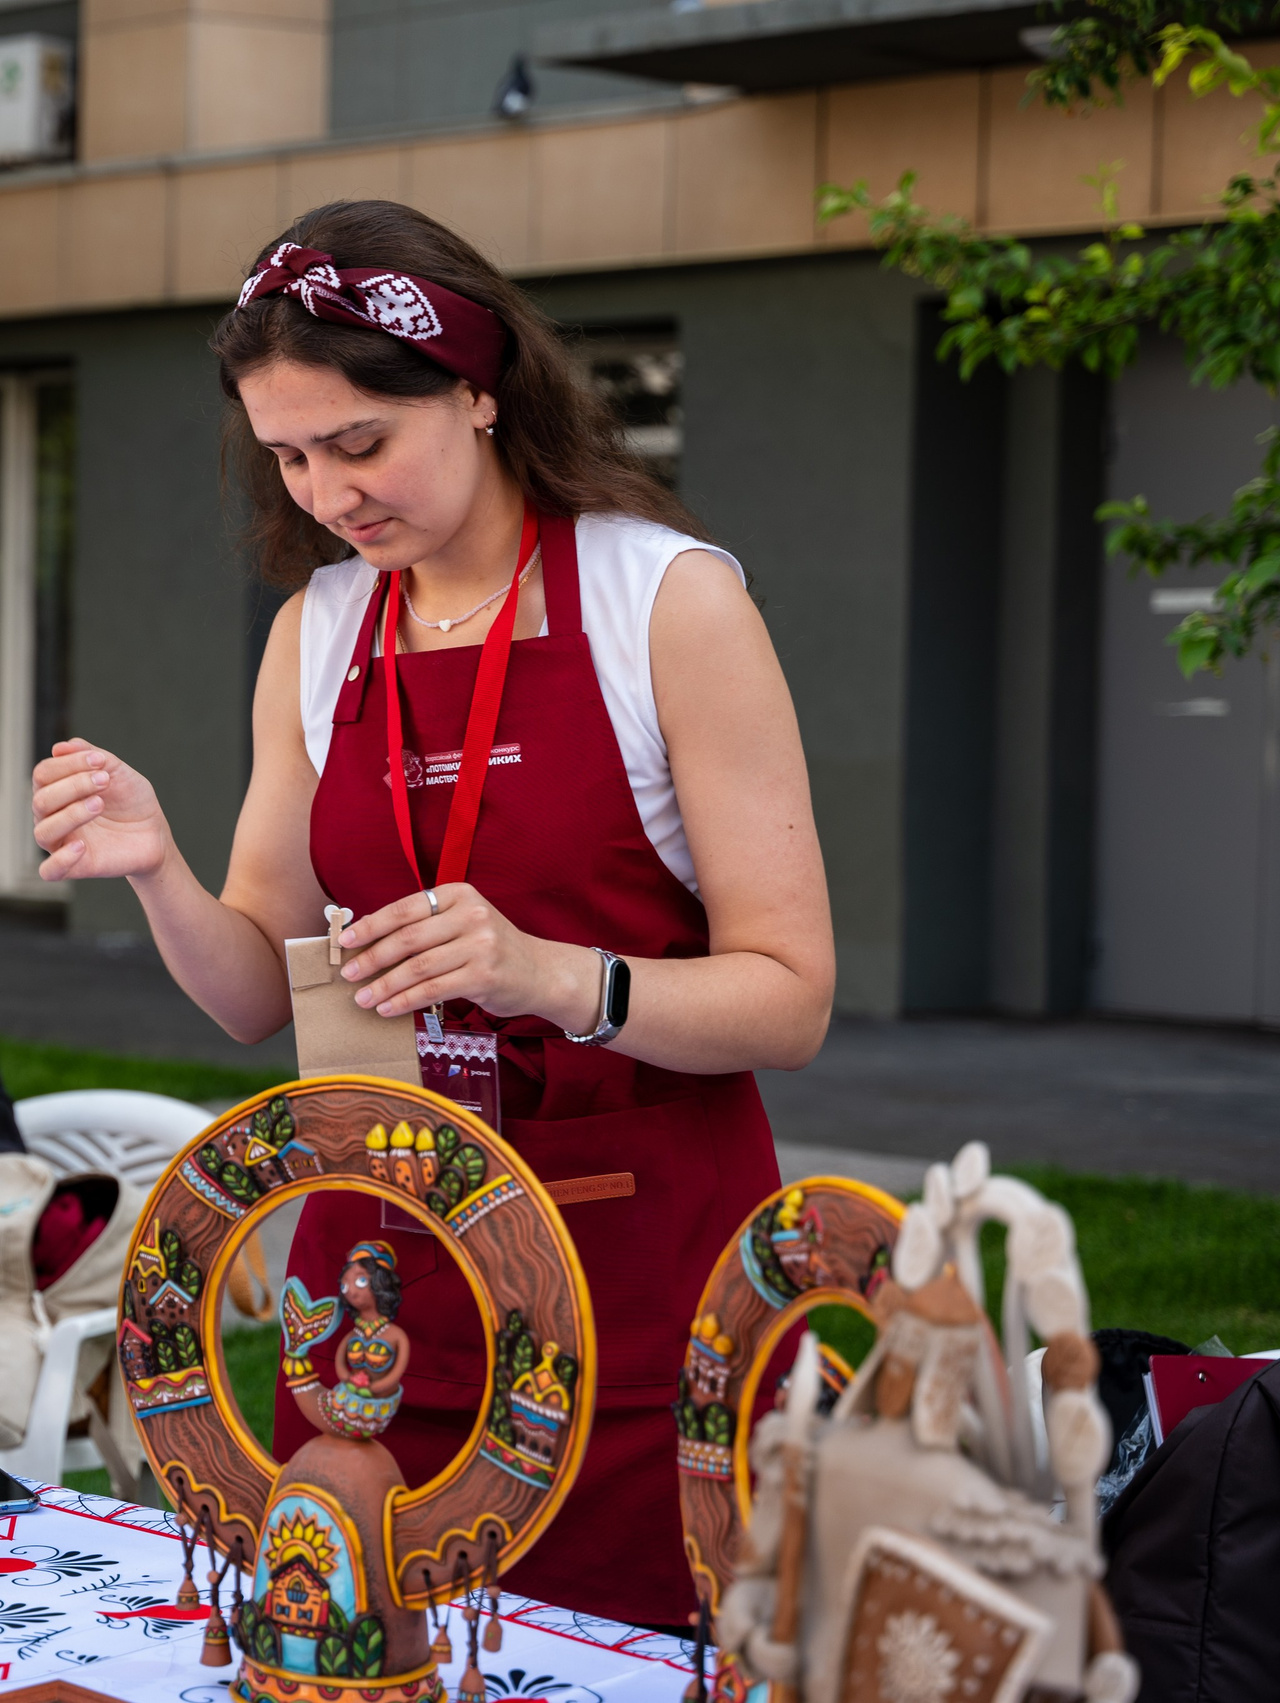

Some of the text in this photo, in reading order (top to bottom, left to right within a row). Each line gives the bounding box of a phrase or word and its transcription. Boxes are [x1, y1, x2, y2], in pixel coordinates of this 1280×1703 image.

[488, 754, 522, 765] ИКИХ
[426, 774, 459, 785] МАСТЕРО
[571, 1186, 596, 1195] FENG
